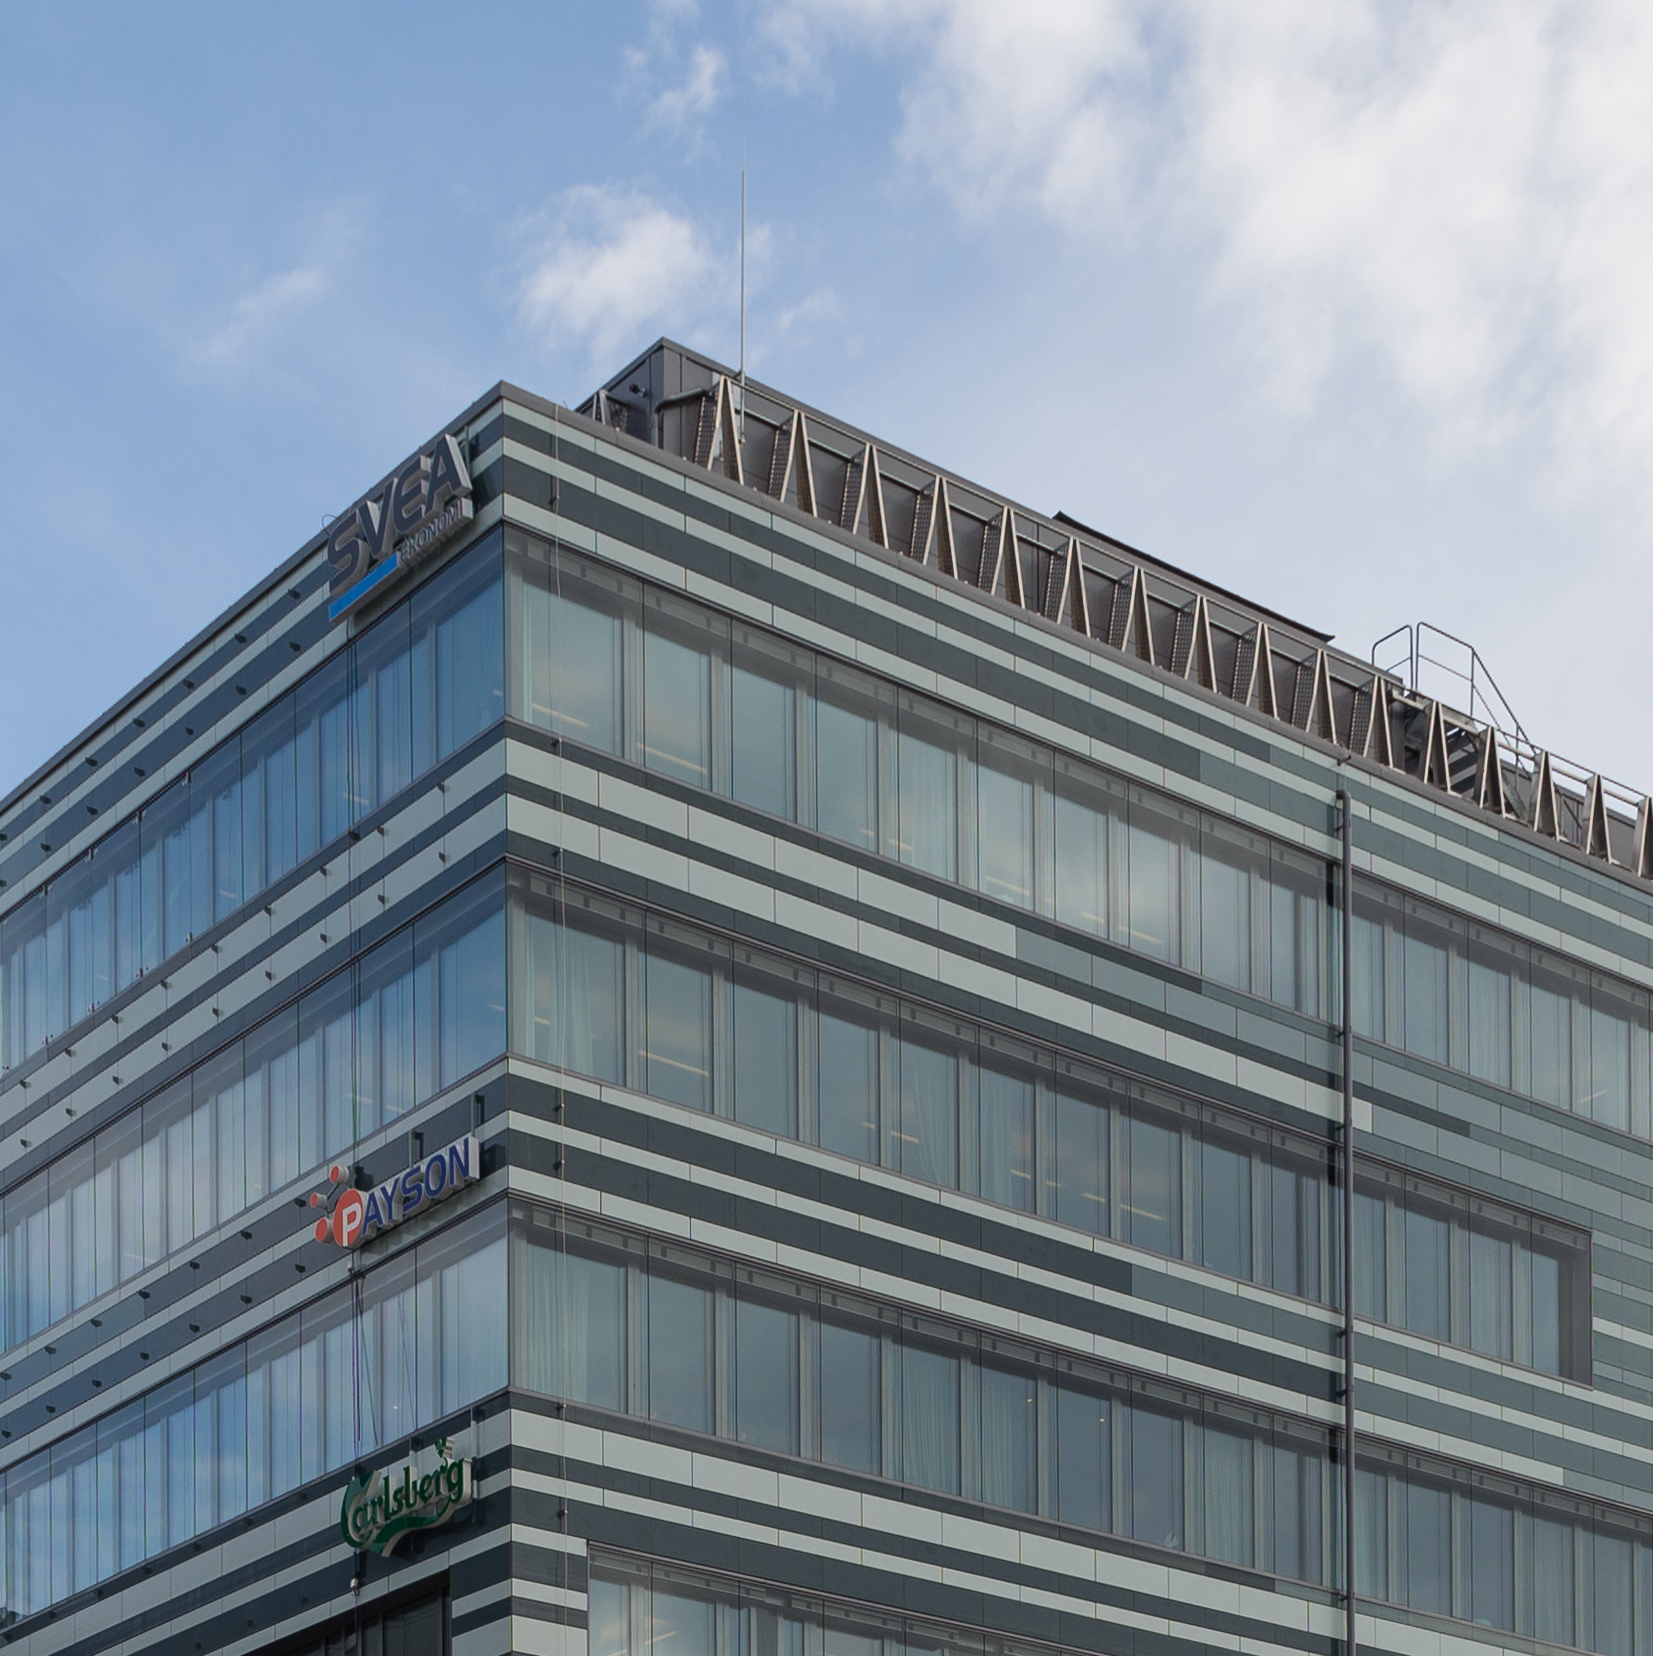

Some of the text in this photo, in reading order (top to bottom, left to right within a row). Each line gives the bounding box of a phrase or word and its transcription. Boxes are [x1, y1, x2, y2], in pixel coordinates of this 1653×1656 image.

[328, 434, 472, 593] SVEA
[342, 1137, 474, 1246] PAYSON
[341, 1457, 468, 1549] Carlsberg
